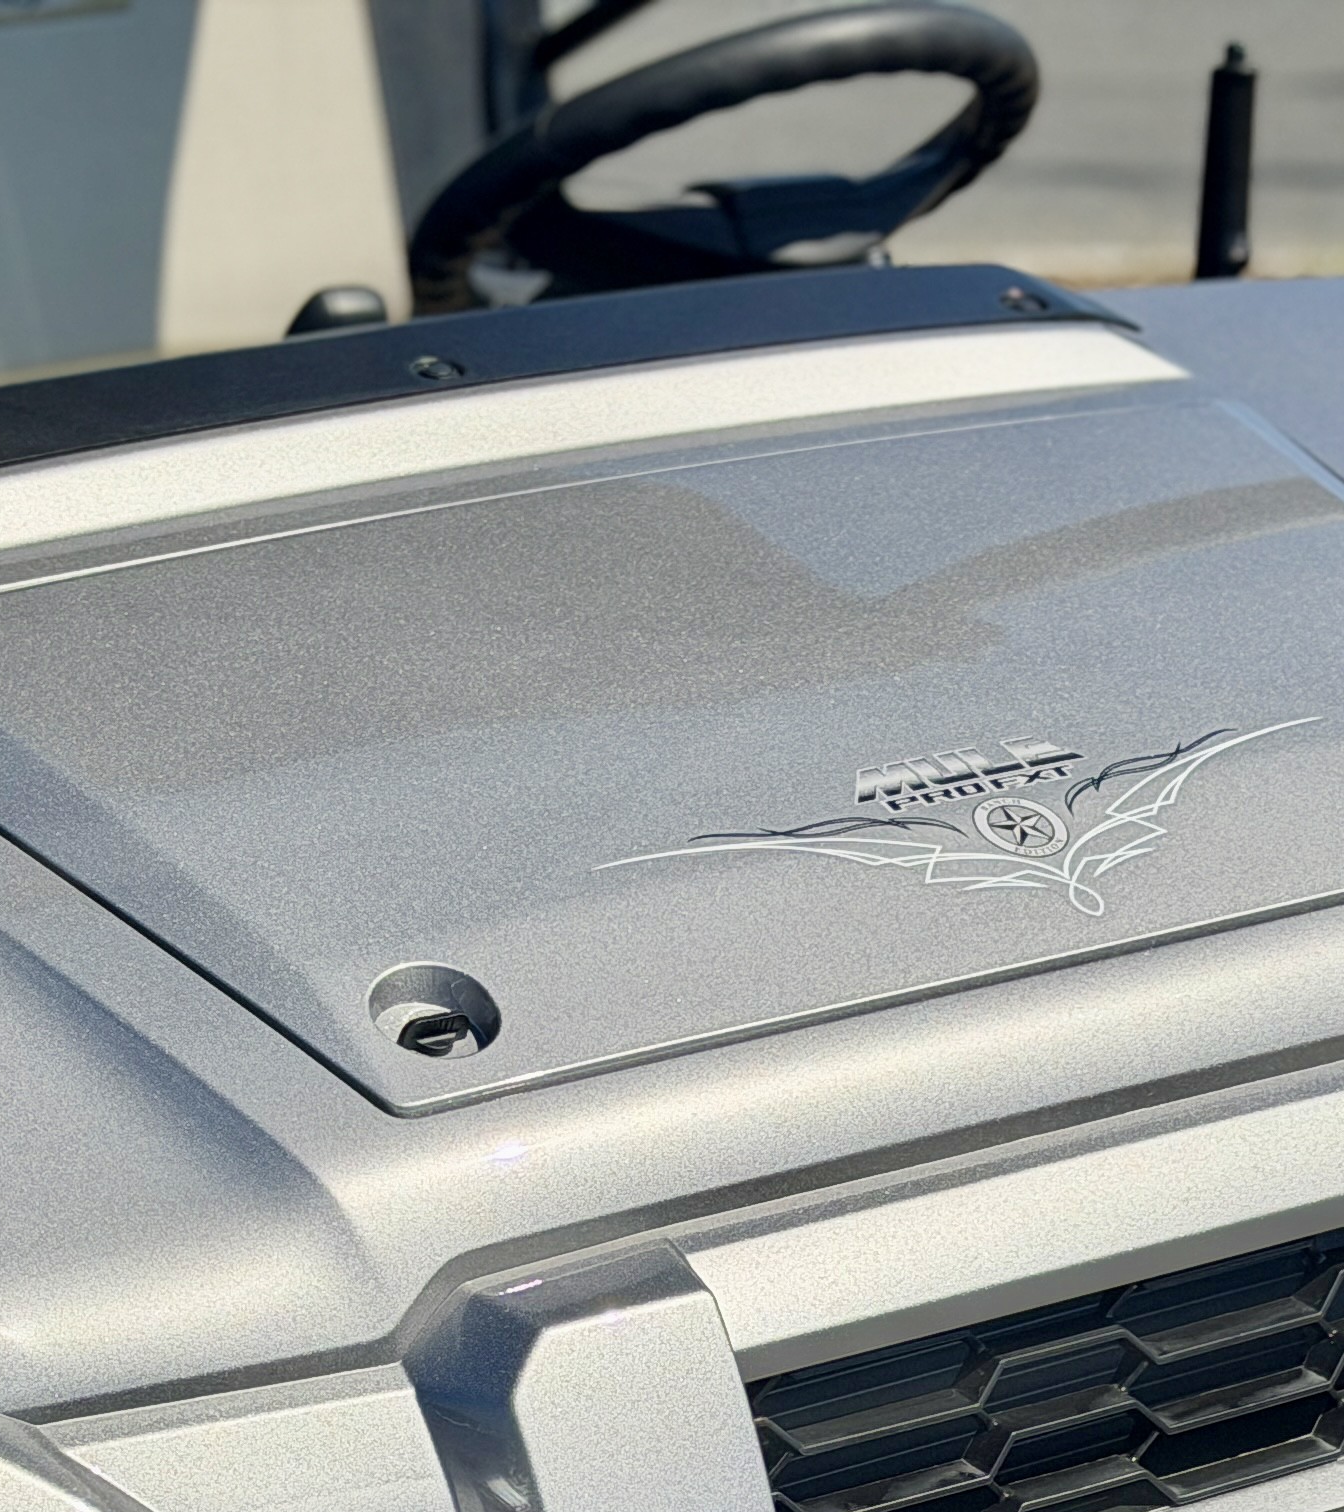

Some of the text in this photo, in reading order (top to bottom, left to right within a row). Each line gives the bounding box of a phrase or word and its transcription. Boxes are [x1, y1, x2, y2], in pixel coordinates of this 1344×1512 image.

[855, 736, 1087, 804] MULE
[883, 764, 1073, 813] PRO FXT
